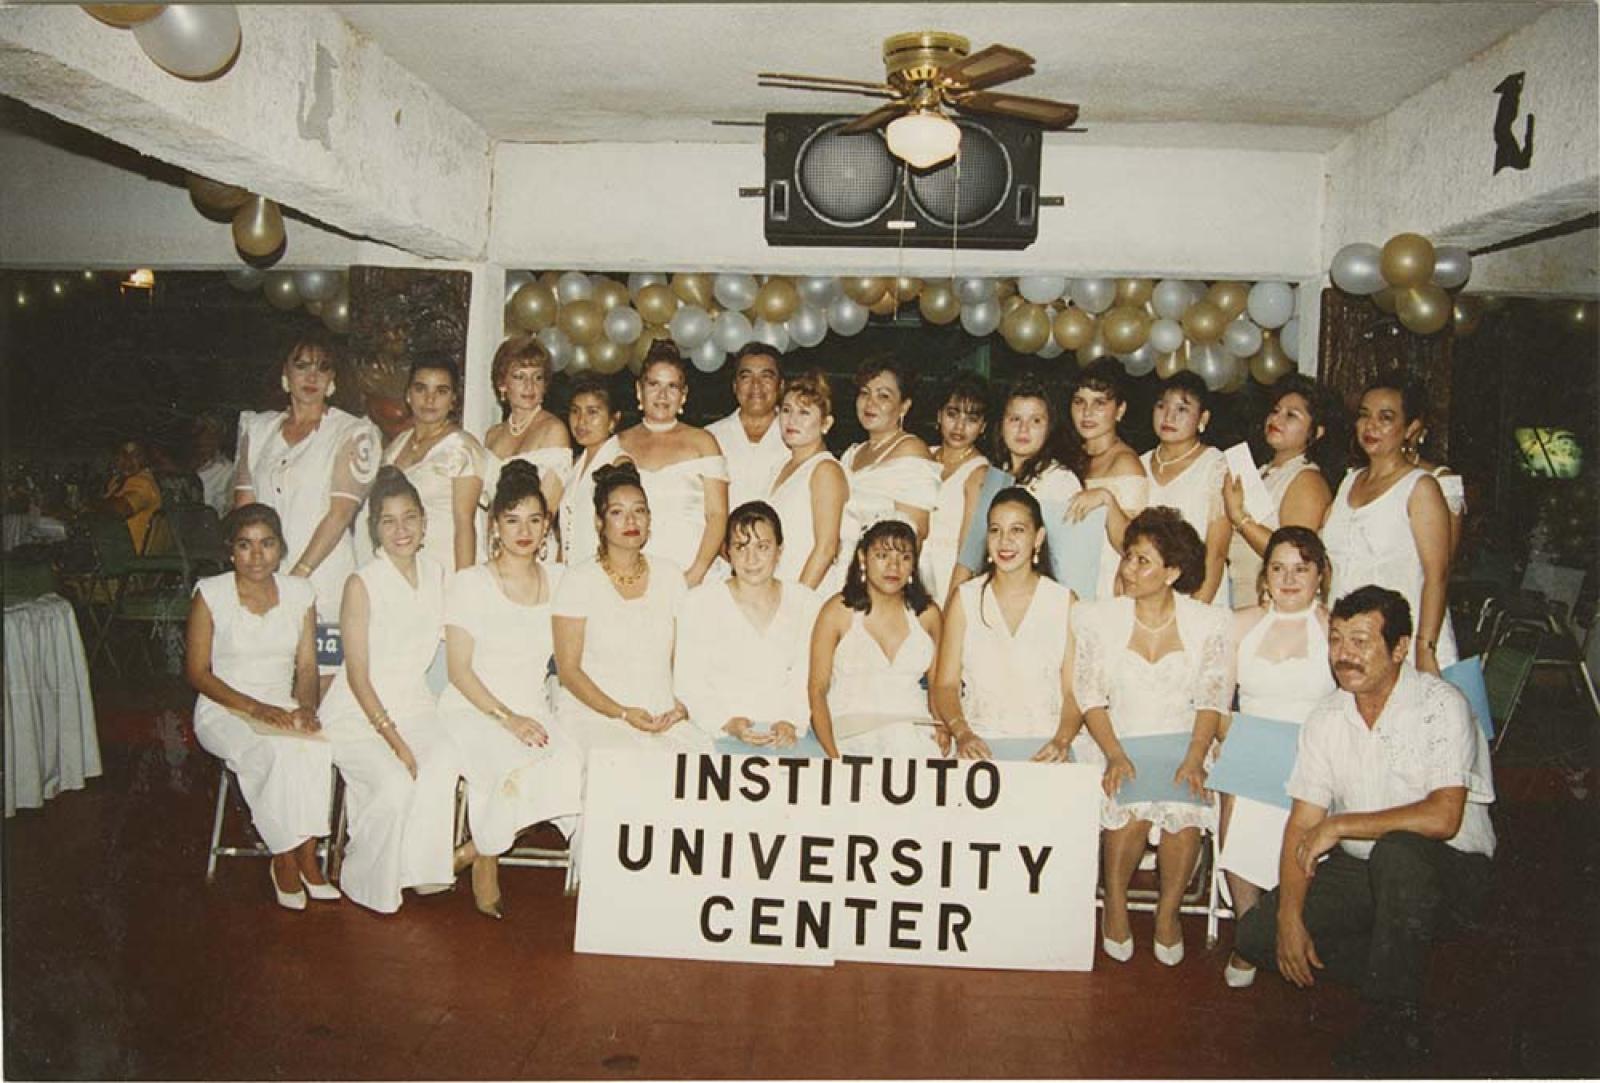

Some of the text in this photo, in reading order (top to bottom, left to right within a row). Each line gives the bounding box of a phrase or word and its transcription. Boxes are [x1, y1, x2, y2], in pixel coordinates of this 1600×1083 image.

[674, 753, 1002, 809] INSTITUTO
[618, 824, 1053, 894] UNIVERSITY
[700, 895, 972, 952] CENTER
